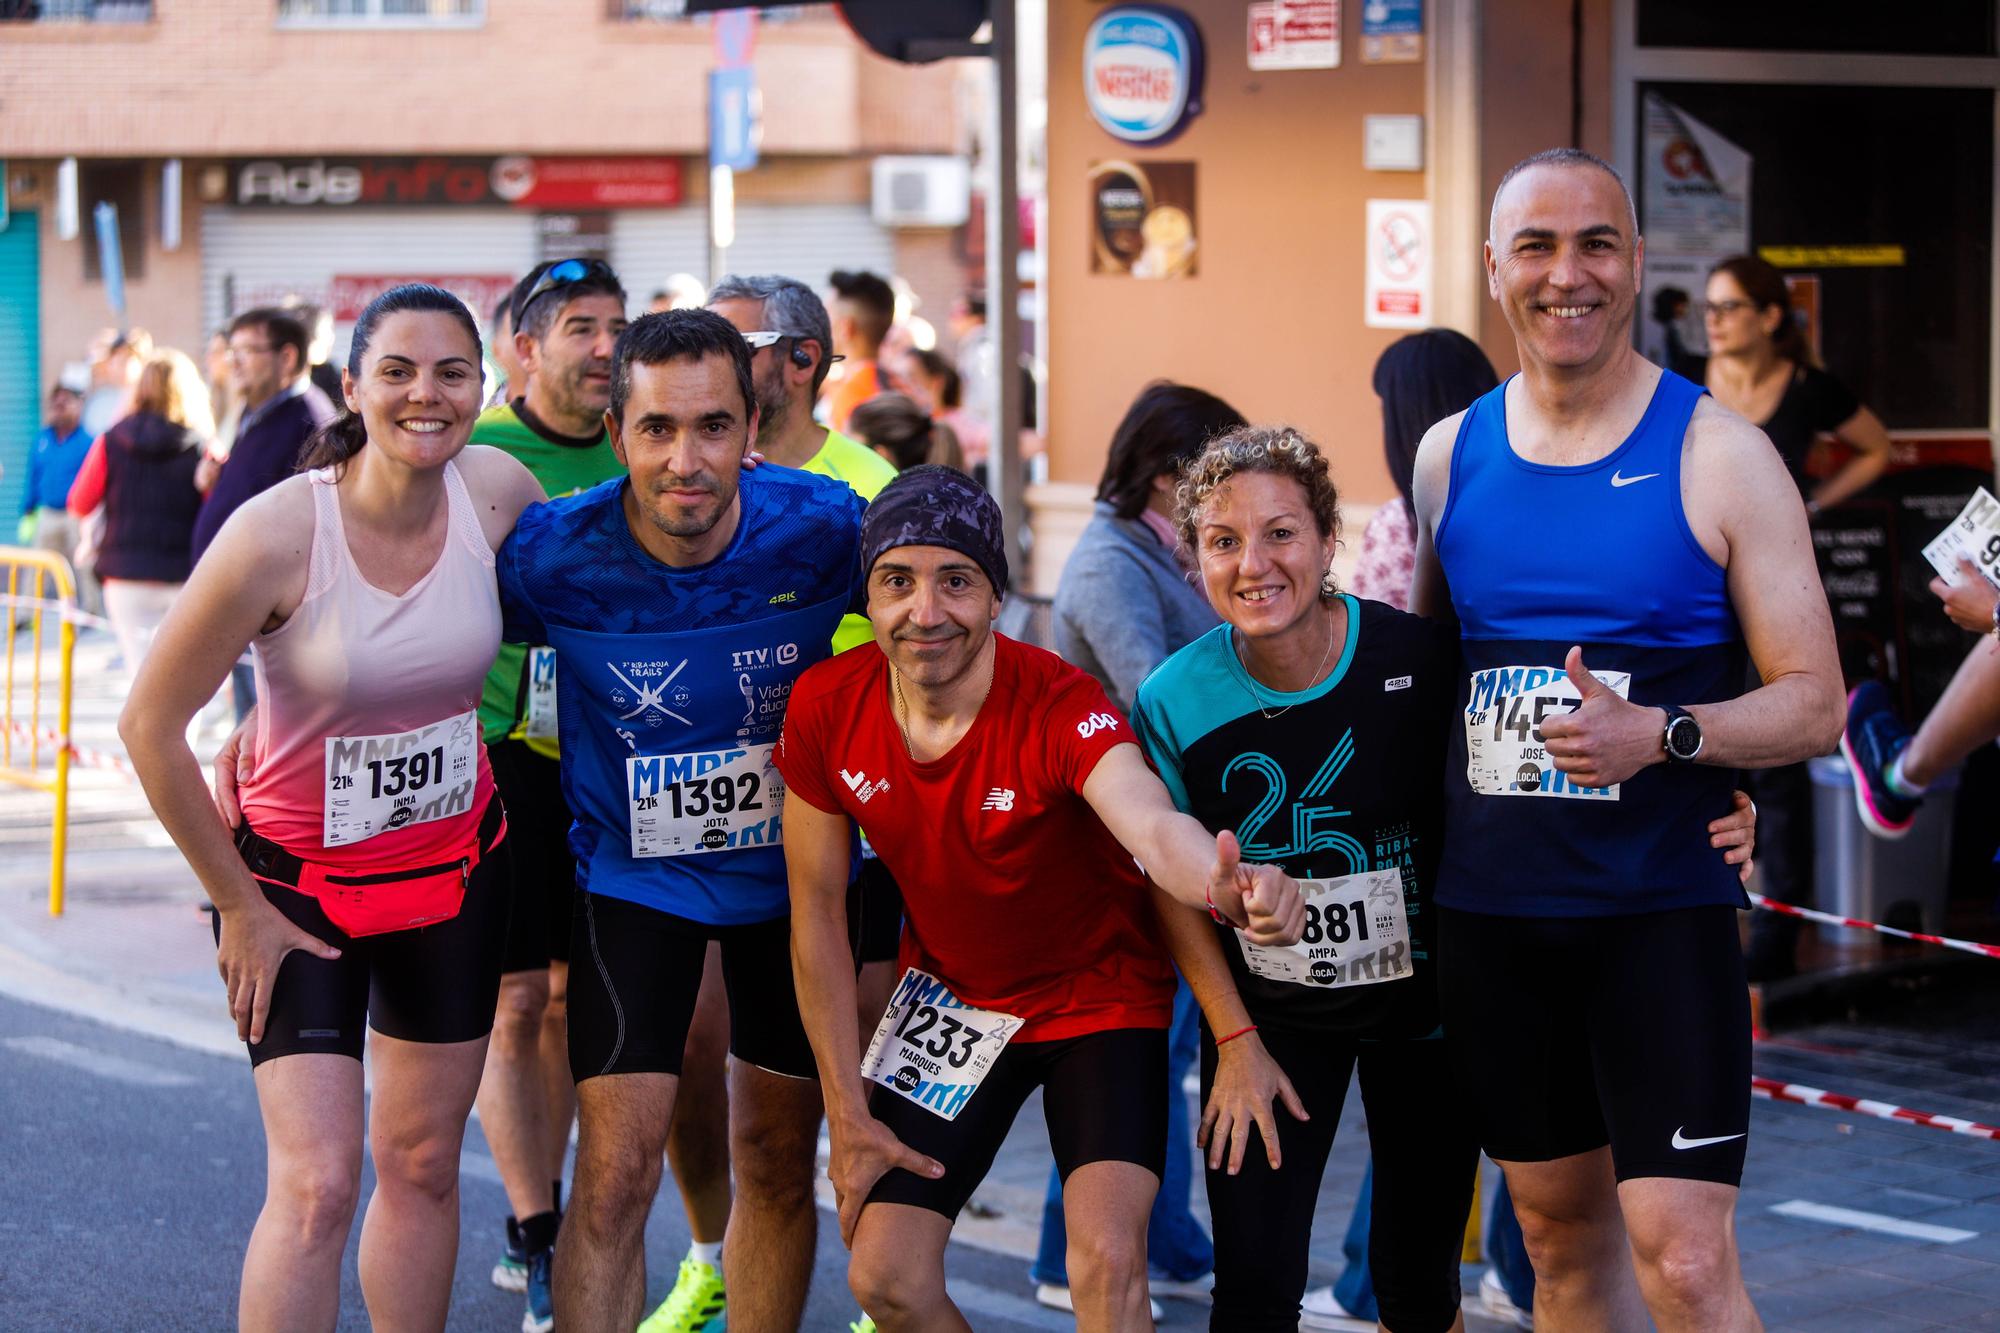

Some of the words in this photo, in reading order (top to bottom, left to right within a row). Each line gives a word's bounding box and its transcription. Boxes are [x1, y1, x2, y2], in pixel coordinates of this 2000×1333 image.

[732, 648, 768, 666] ITV
[630, 668, 663, 677] TRAILS
[1520, 748, 1545, 760] JOSE
[368, 746, 443, 799] 1391
[1517, 772, 1541, 782] LOCAL
[332, 776, 353, 790] 21k
[394, 795, 416, 808] INMA
[667, 772, 762, 819] 1392
[637, 797, 658, 811] 21k
[389, 811, 411, 822] LOCAL
[703, 818, 729, 828] JOTA
[702, 834, 728, 843] LOCAL
[1308, 947, 1338, 960] AMPA
[1310, 968, 1337, 978] LOCAL
[895, 1001, 984, 1068] 1233
[899, 1046, 942, 1076] MARQUES
[896, 1070, 919, 1088] LOCAL
